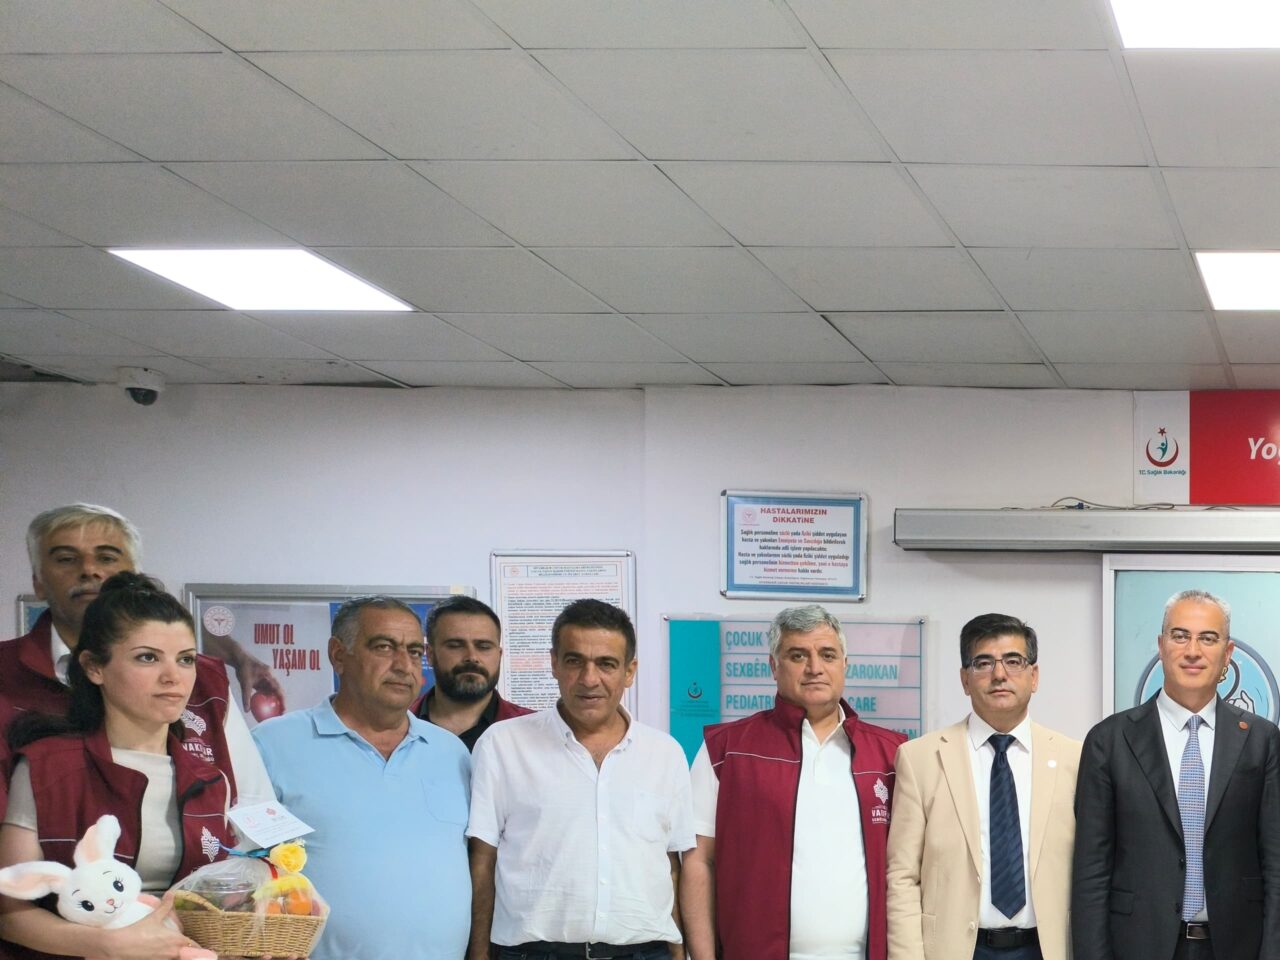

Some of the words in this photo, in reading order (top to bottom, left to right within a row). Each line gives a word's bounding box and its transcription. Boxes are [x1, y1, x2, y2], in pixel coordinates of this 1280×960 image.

[254, 623, 280, 645] UMUT
[283, 624, 295, 645] OL
[726, 631, 763, 650] ÇOCUK
[272, 648, 306, 676] YAŞAM
[310, 650, 320, 671] OL
[845, 664, 898, 679] ZAROKAN
[726, 695, 774, 710] PEDIATRI
[848, 696, 877, 712] CARE
